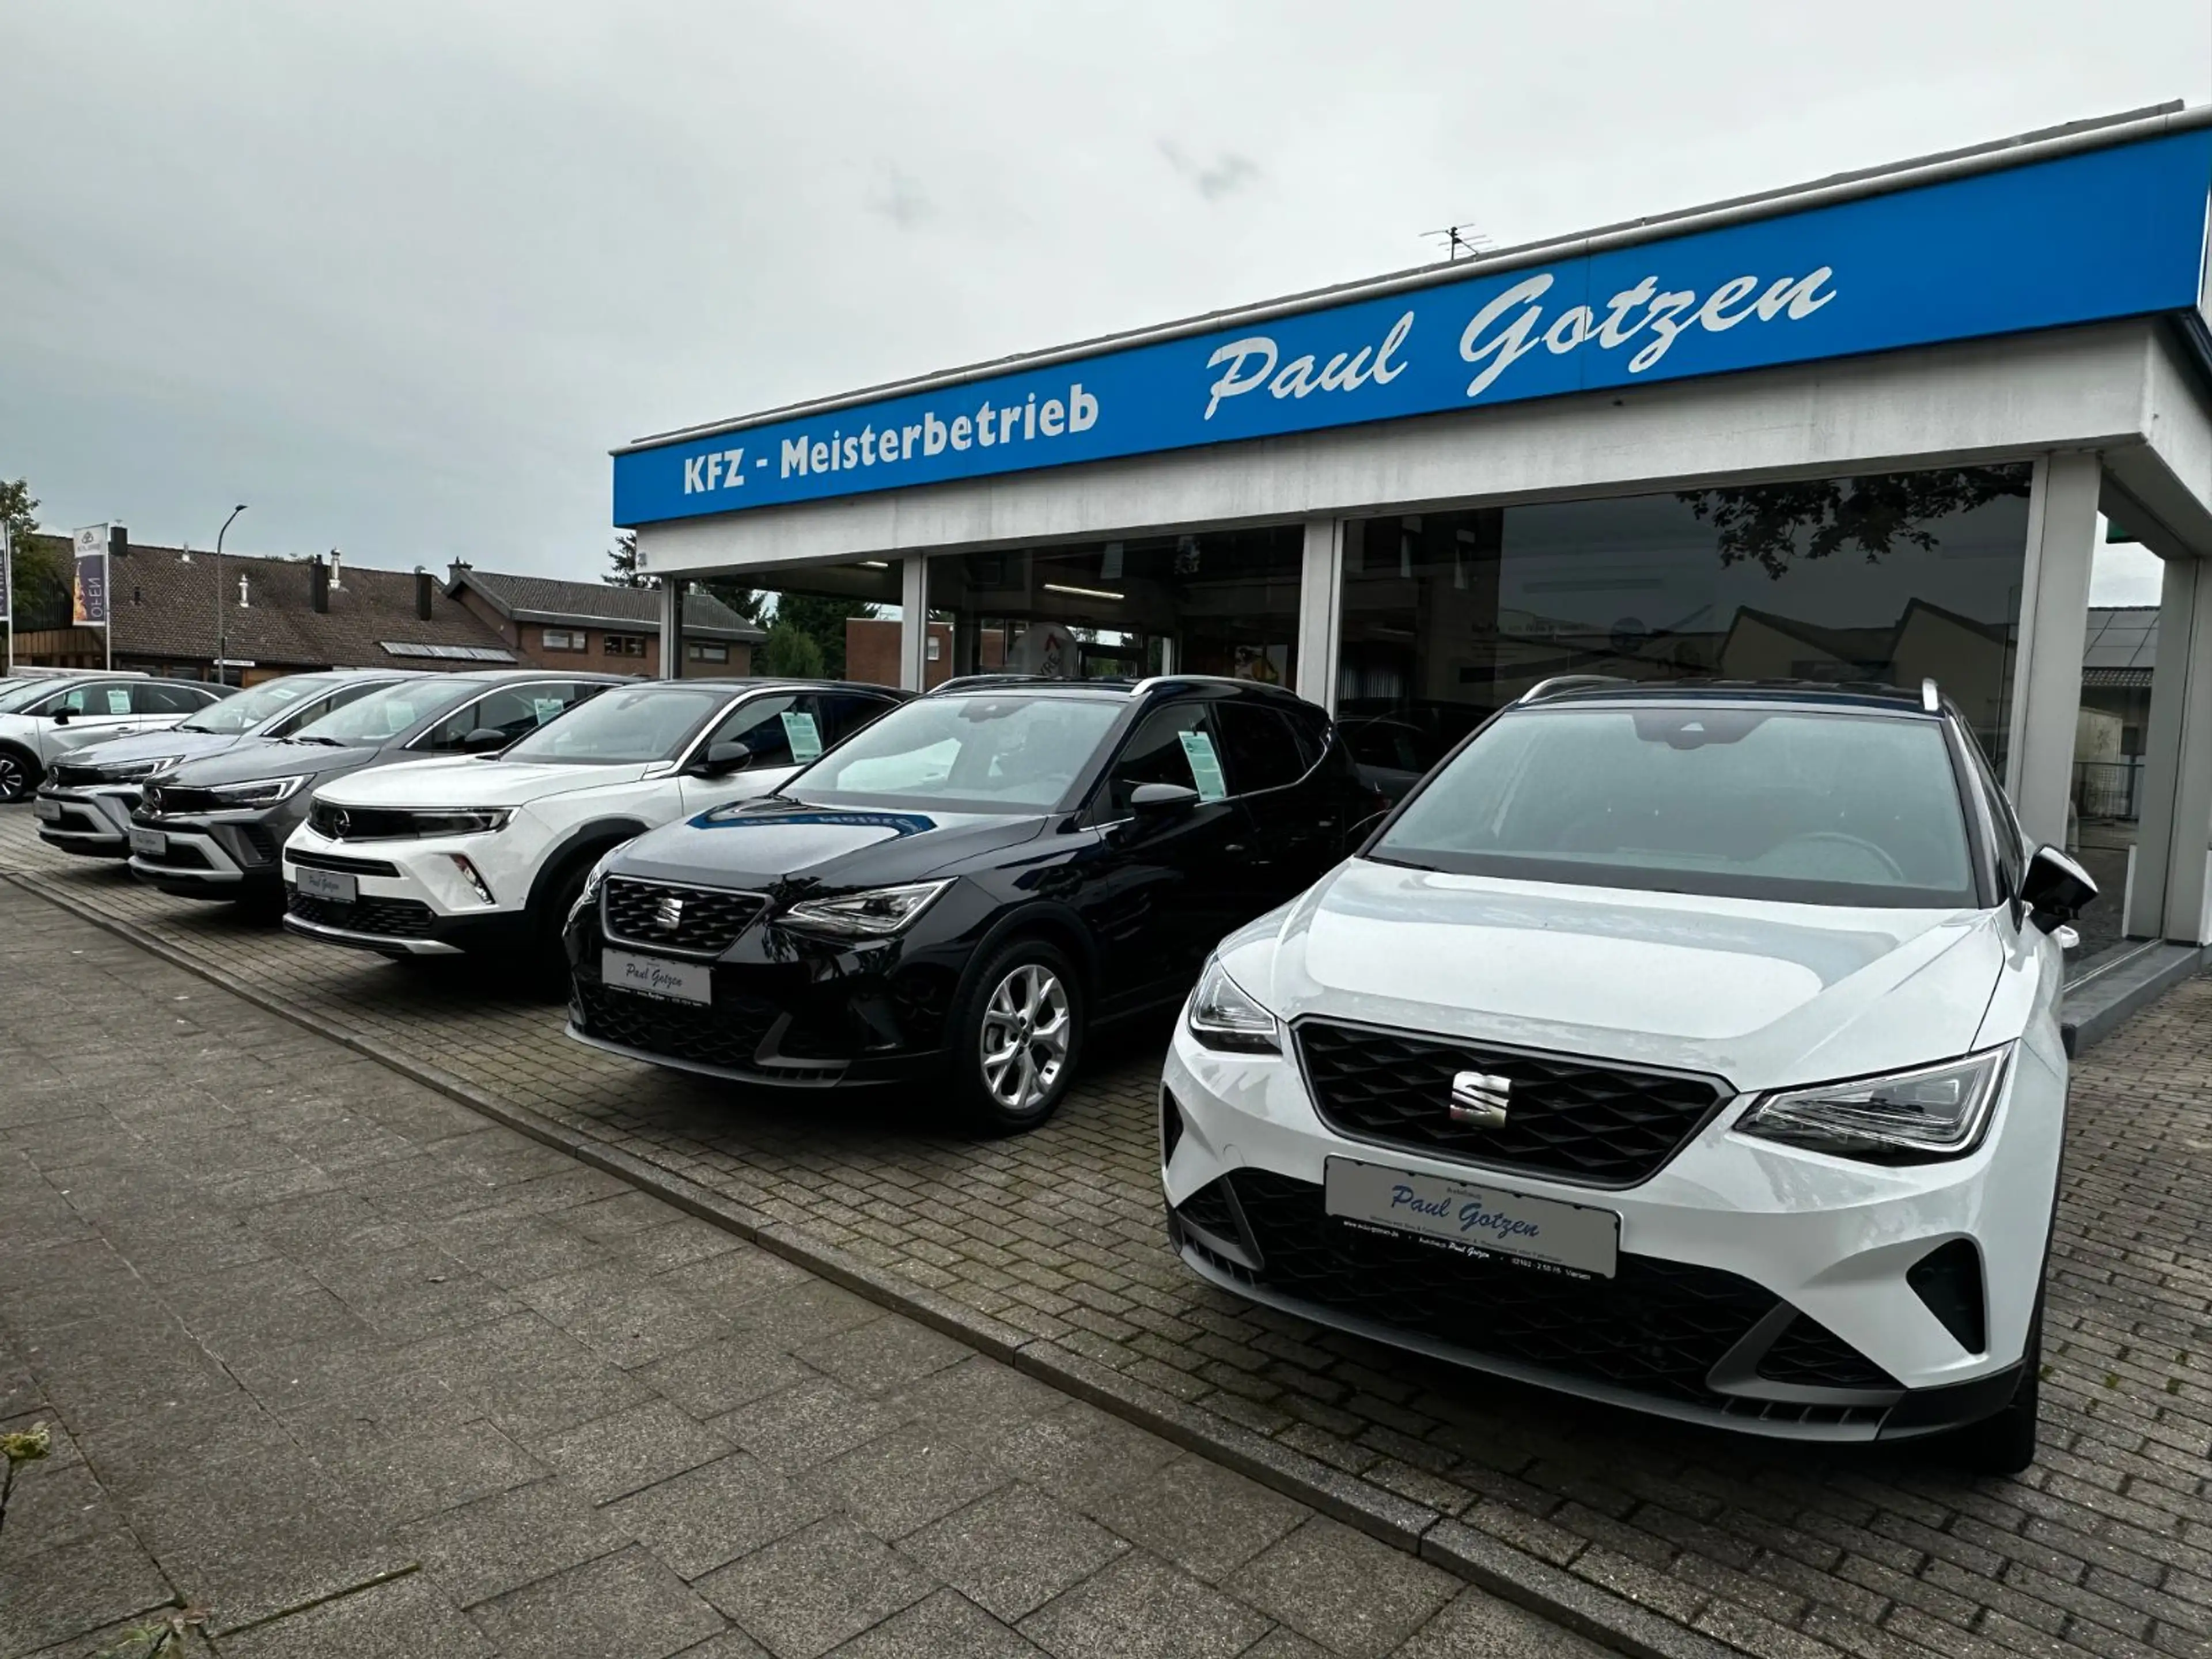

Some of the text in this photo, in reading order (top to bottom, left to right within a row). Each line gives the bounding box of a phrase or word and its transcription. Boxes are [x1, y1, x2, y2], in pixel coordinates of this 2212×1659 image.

[684, 266, 1836, 494] KFZ - Meisterbetrieb Paul Gotzen
[626, 963, 683, 989] Paul Gotzen
[1391, 1185, 1451, 1217] Paul
[1459, 1202, 1540, 1239] Gotzen
